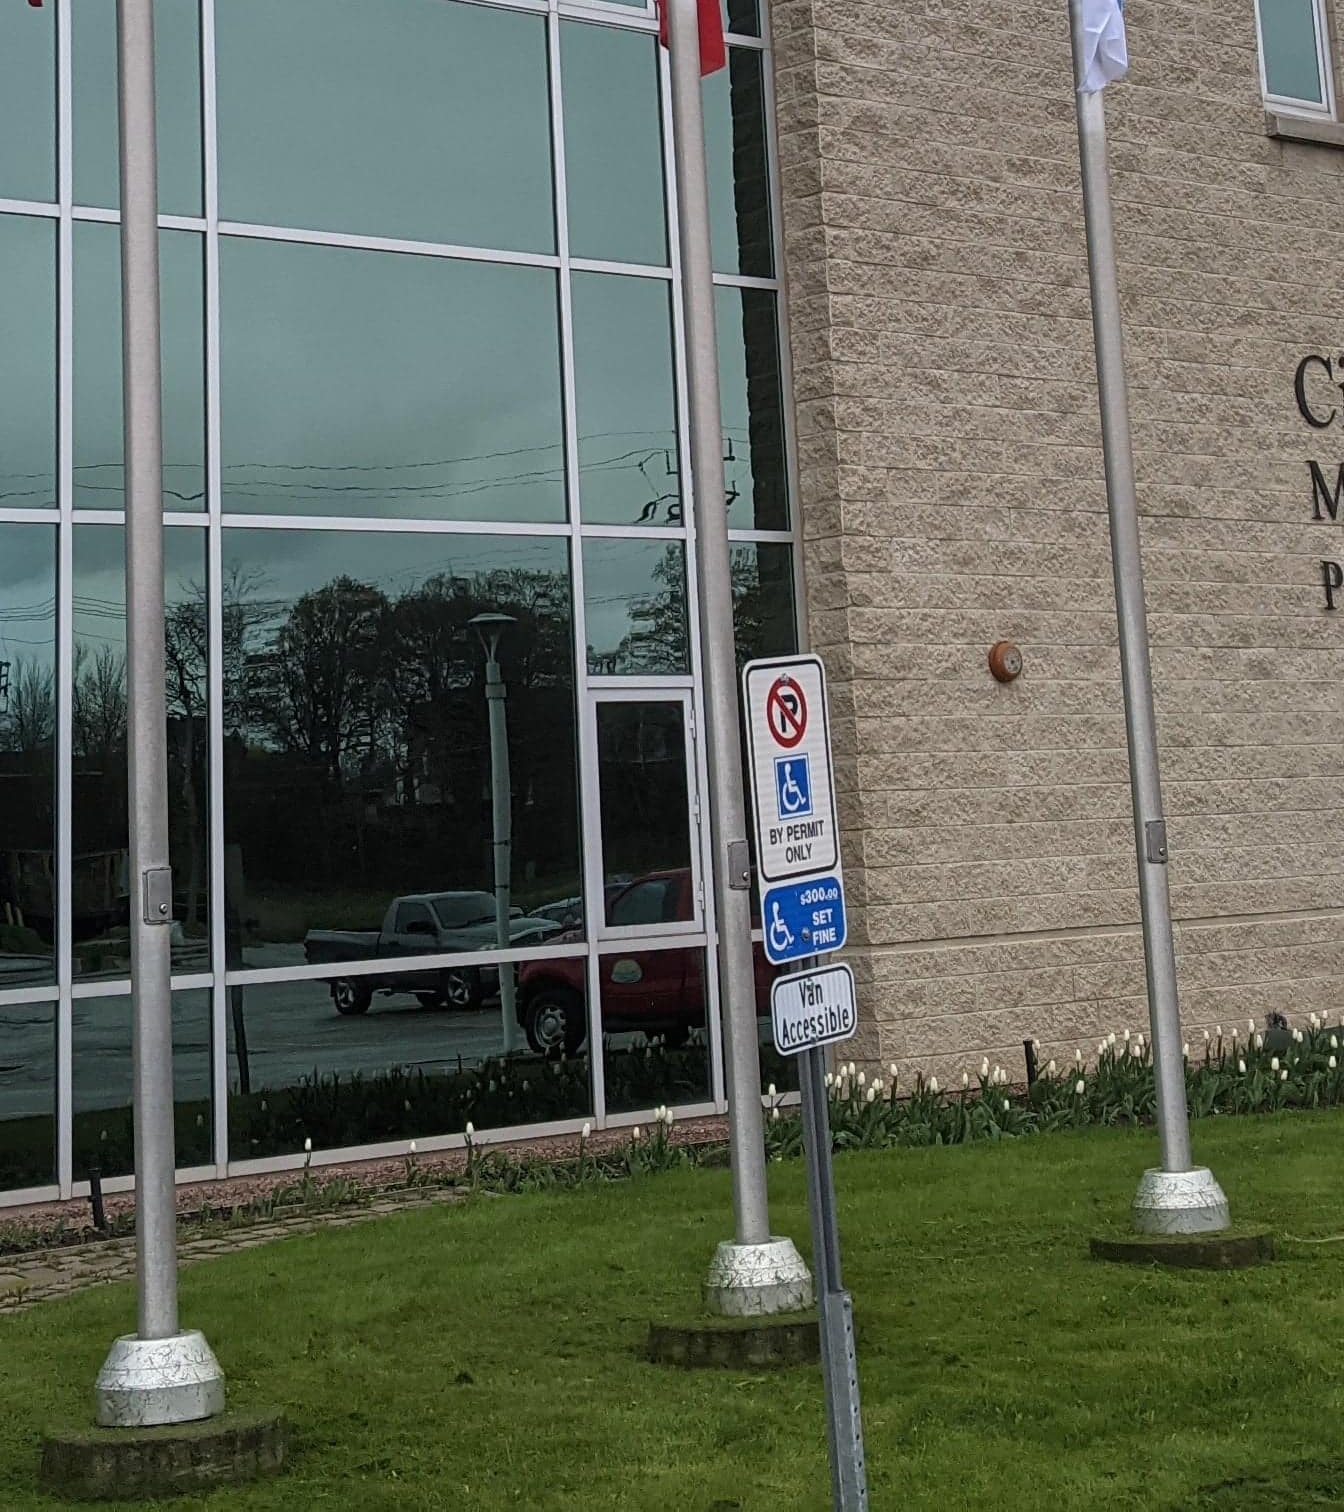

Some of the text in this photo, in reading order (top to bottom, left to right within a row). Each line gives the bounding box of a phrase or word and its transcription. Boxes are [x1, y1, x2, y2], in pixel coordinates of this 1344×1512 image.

[769, 820, 824, 845] BY PERMIT
[785, 843, 812, 863] ONLY
[800, 887, 838, 905] $300.00
[812, 909, 833, 925] SET
[812, 928, 836, 945] FINE
[799, 981, 824, 1008] Van
[782, 1004, 849, 1046] Accessible
